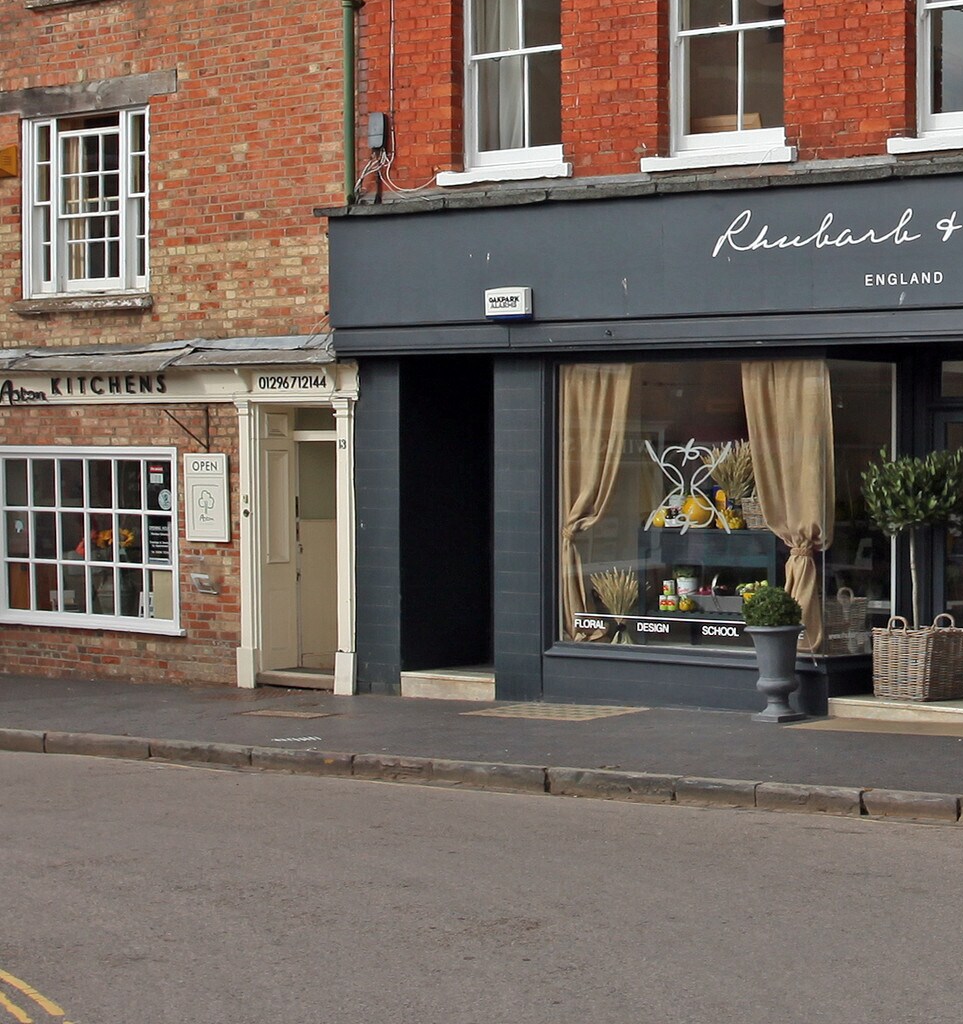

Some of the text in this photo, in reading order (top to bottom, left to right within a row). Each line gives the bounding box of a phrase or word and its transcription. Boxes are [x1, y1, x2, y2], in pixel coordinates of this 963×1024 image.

[712, 209, 921, 257] Rhubarb
[864, 271, 943, 286] ENGLAND
[51, 375, 168, 395] KITCHENS
[192, 461, 218, 472] OPEN
[574, 619, 739, 637] FLORAL DESIGN SCHOOL
